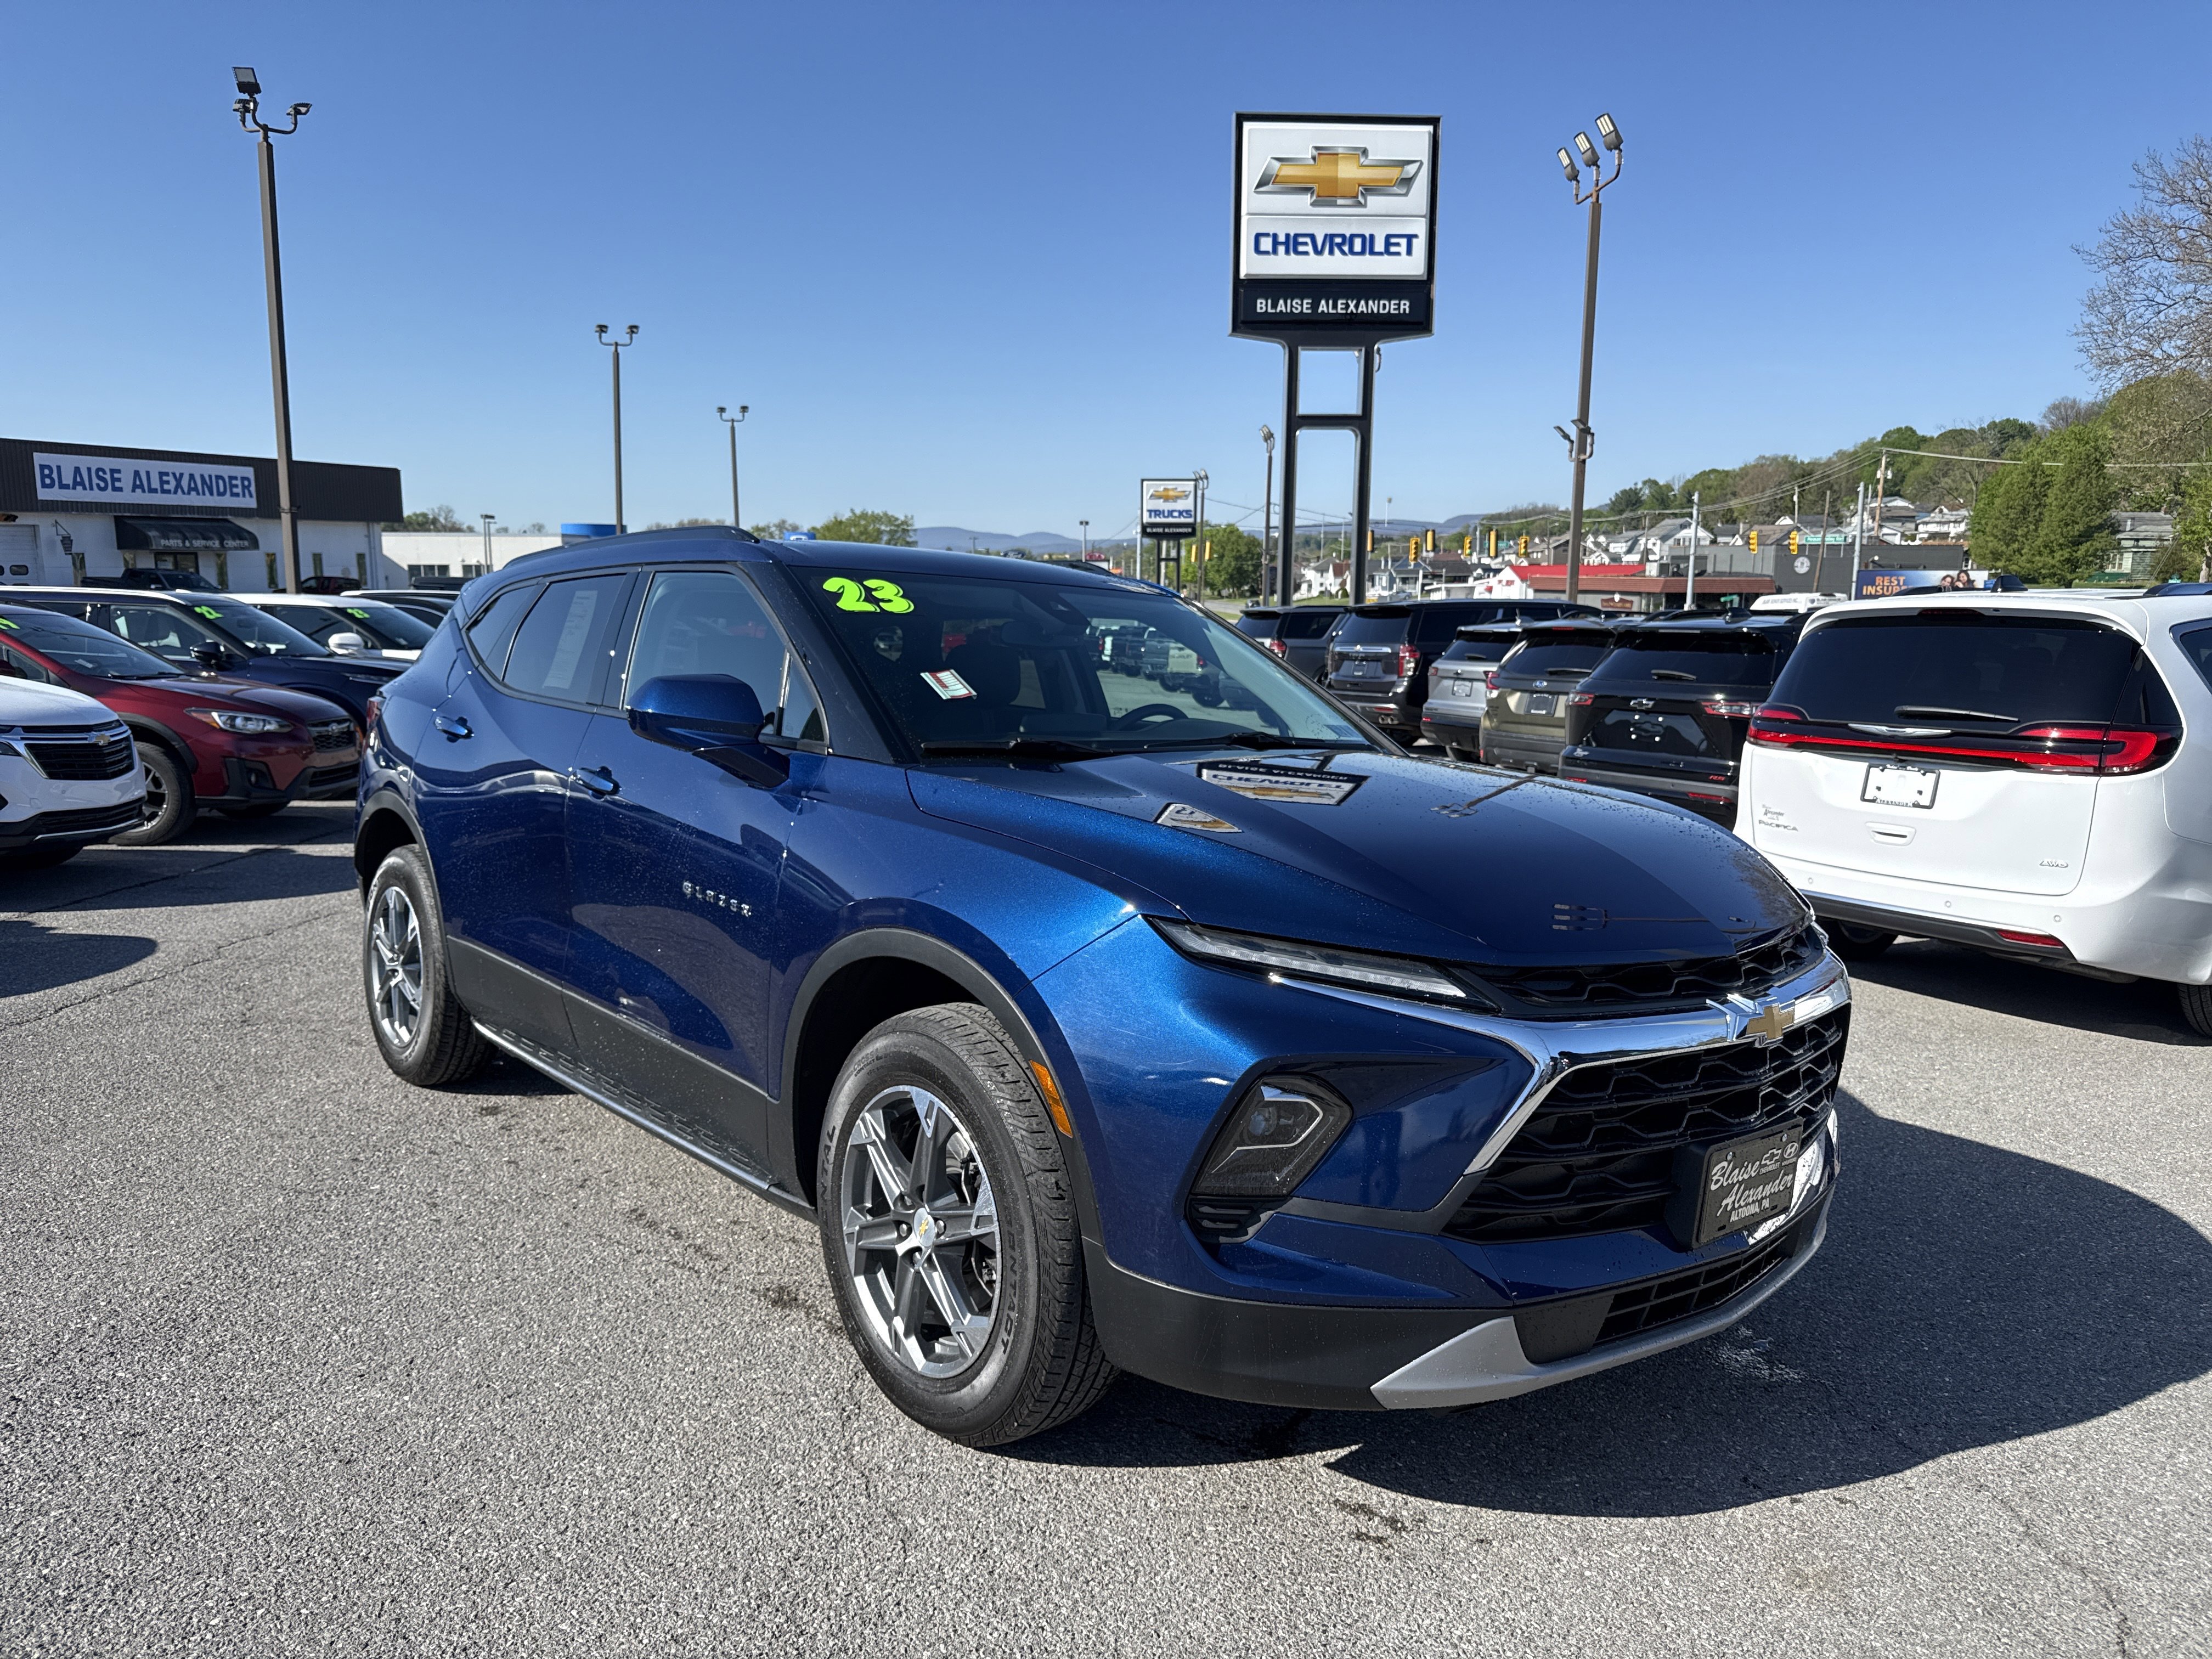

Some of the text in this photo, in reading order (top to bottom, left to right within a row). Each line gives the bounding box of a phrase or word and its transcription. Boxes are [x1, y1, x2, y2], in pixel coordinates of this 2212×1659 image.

[1254, 232, 1419, 257] CHEVROLET
[1256, 298, 1410, 314] BLAISE ALEXANDER
[38, 464, 254, 499] BLAISE ALEXANDER
[1147, 509, 1193, 519] TRUCKS
[160, 539, 183, 548] PARTS
[192, 540, 221, 548] SERVICE
[1863, 585, 1914, 596] INSUR
[1875, 576, 1905, 586] REST
[822, 577, 915, 613] 23
[2039, 859, 2069, 868] AWD
[682, 880, 752, 918] BLAZER
[1710, 1159, 1760, 1191] Blaise
[1717, 1169, 1794, 1217] Alexander
[1729, 1199, 1770, 1223] ALTOONA, PA
